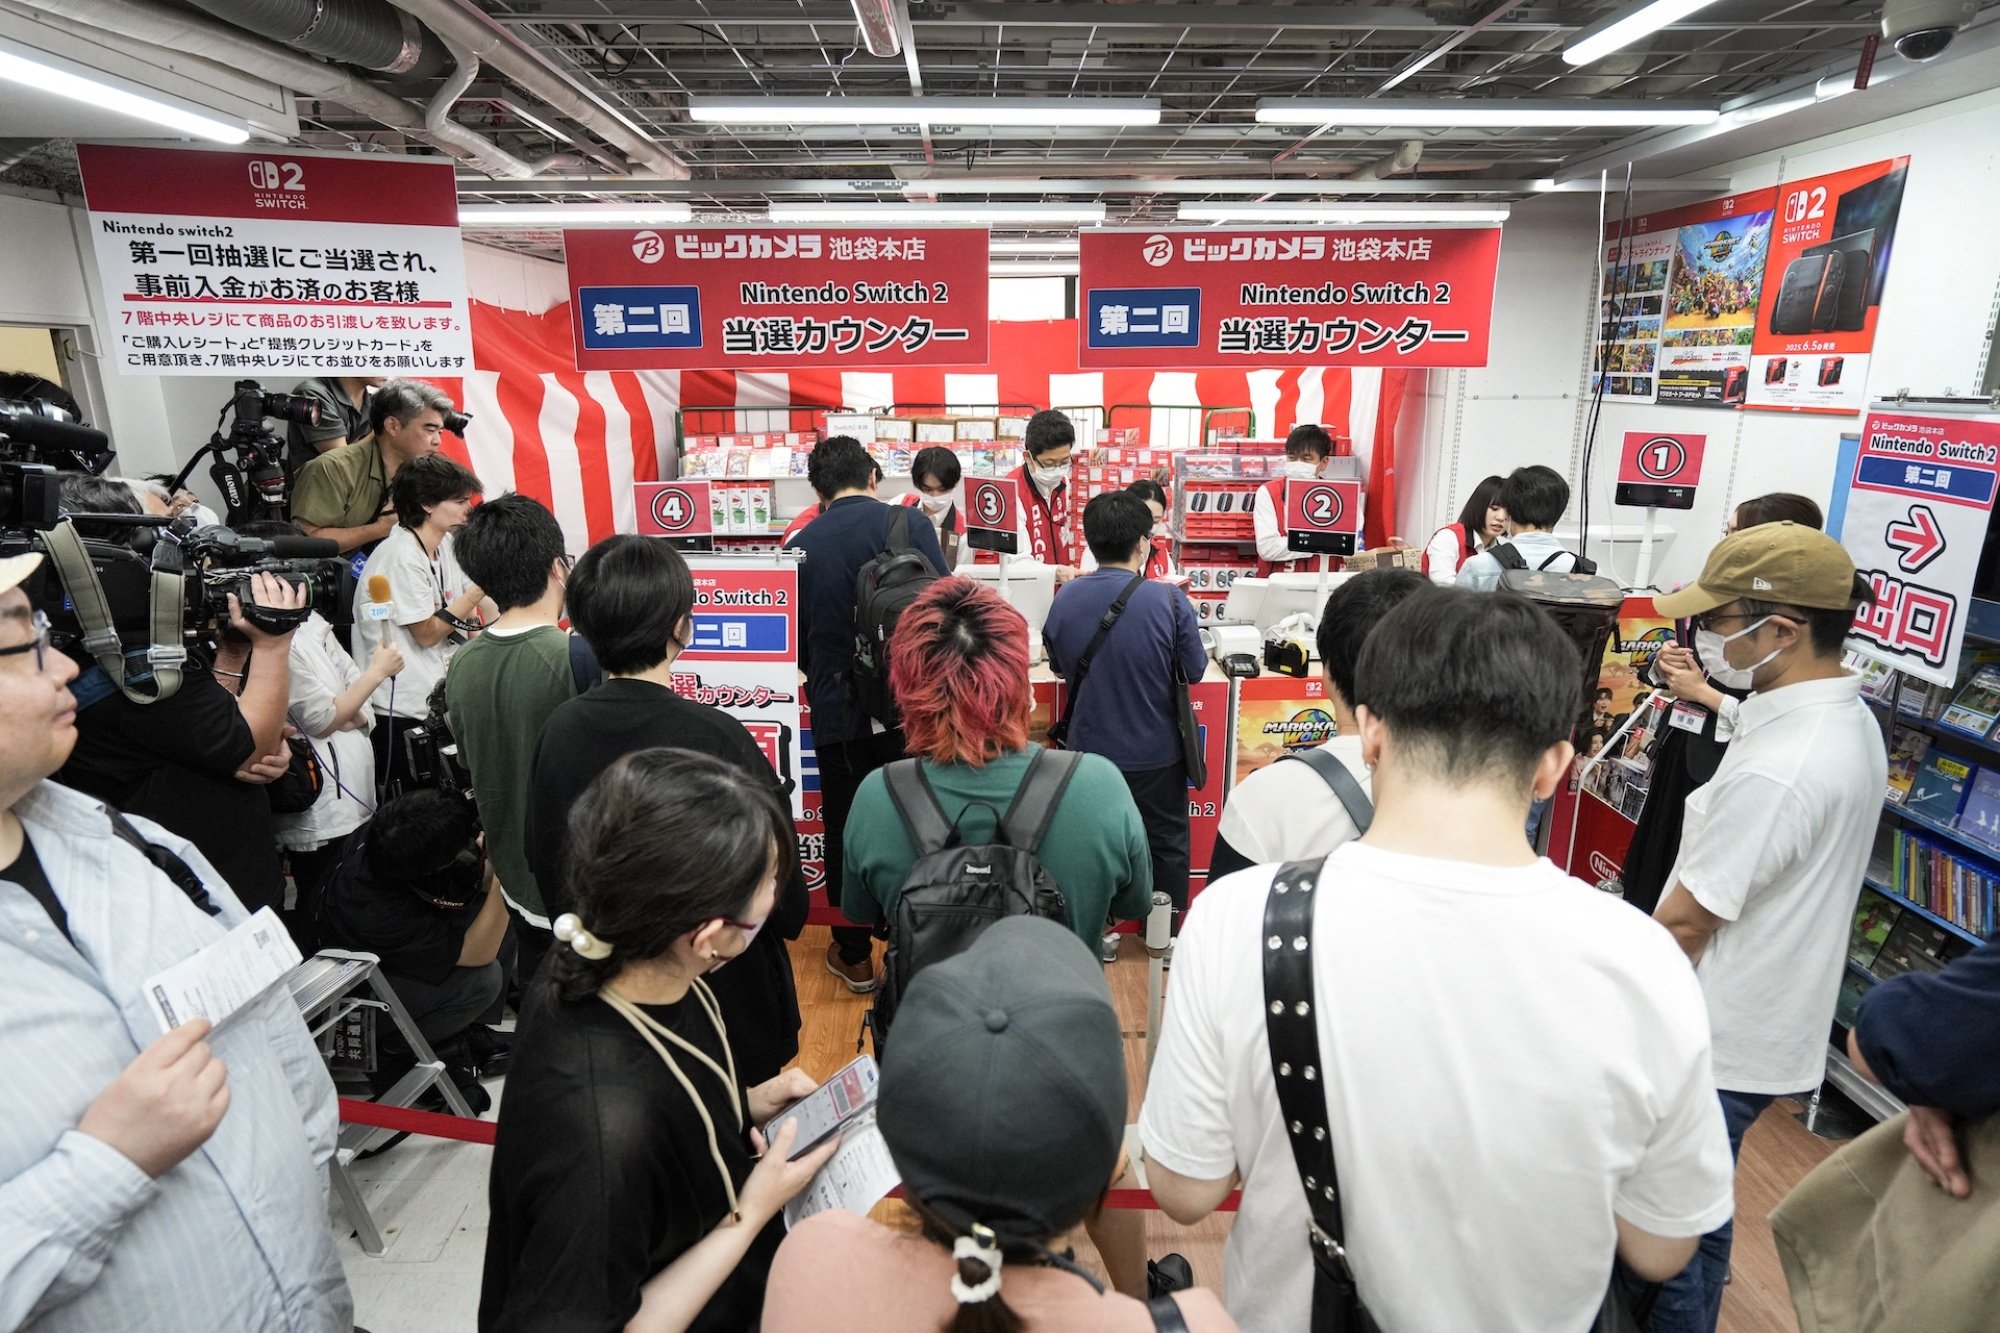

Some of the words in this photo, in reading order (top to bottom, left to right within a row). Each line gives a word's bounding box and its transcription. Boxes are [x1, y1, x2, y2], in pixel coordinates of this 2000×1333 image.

[254, 192, 306, 201] NINTENDO
[255, 198, 307, 209] SWITCH
[102, 220, 175, 237] Nintendo
[177, 222, 235, 239] switch2
[1782, 229, 1821, 244] SWITCH
[1783, 222, 1821, 234] NINTENDO
[128, 240, 438, 274] 第一回抽選にご当選され、
[674, 234, 822, 260] ビックカメラ
[828, 236, 927, 261] 池袋本店
[1183, 235, 1326, 261] ビックカメラ
[1331, 237, 1432, 261] 池袋本店
[135, 273, 421, 304] 事前入金がお済のお客様
[741, 282, 848, 304] Nintendo
[853, 281, 928, 303] Switch
[933, 281, 948, 303] 2
[1240, 284, 1349, 306] Nintendo
[1353, 283, 1430, 304] Switch
[1434, 282, 1451, 304] 2
[593, 303, 691, 337] 第二回
[1099, 303, 1191, 336] 第二回
[722, 317, 969, 355] 当選カウンター
[1217, 317, 1470, 355] 当選カウンター
[1870, 434, 1933, 455] Nintendo
[1938, 441, 1985, 461] Switch
[1985, 447, 1997, 463] 2
[1904, 465, 1952, 489] 第二回
[713, 589, 772, 606] Switch
[776, 589, 788, 606] 2
[1848, 570, 1955, 667] 出口
[1204, 803, 1216, 816] 2
